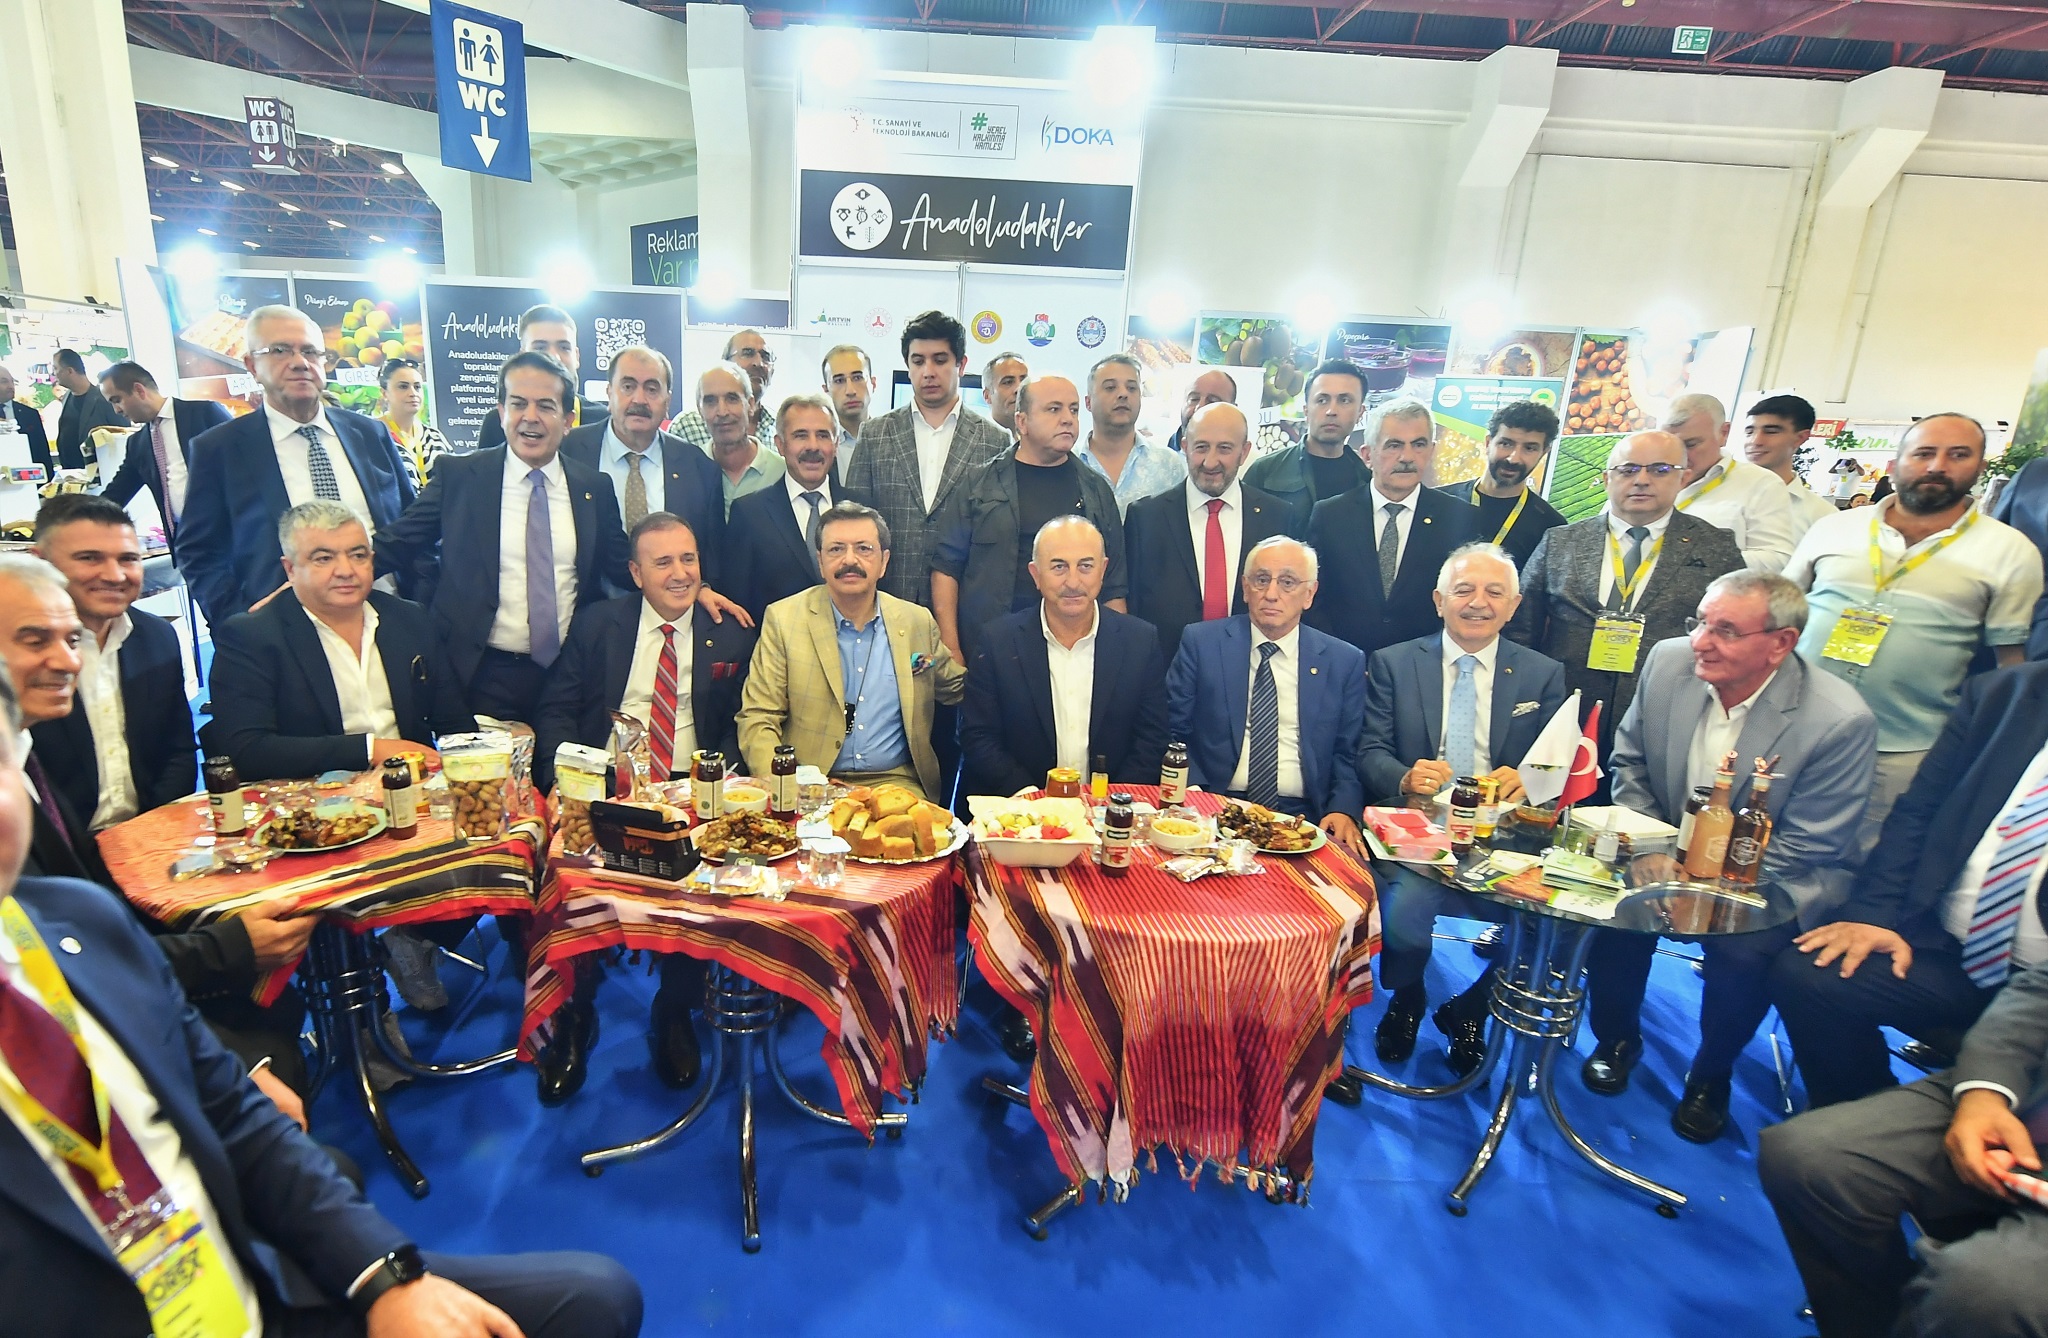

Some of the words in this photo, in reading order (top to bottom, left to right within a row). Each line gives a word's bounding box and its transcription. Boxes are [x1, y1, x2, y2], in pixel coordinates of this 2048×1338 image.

[457, 80, 507, 117] WC
[248, 100, 276, 117] WC
[279, 103, 294, 124] WC
[886, 119, 911, 128] SANAYİ
[872, 128, 910, 136] TEKNOLOJİ
[911, 130, 950, 138] BAKANLIĞI
[1054, 126, 1114, 146] DOKA
[900, 193, 1092, 252] Anadoludakiler
[647, 229, 699, 254] Reklam
[648, 255, 683, 285] Var
[441, 311, 521, 340] Anadoludakil
[448, 350, 509, 361] Anadoludakiler
[463, 362, 501, 372] topraklar
[344, 371, 377, 383] GIRES
[450, 384, 495, 394] platformda
[455, 395, 476, 405] yerel
[477, 396, 499, 404] üretic
[463, 406, 492, 414] destek
[447, 417, 483, 427] geleneks
[464, 440, 479, 448] yer
